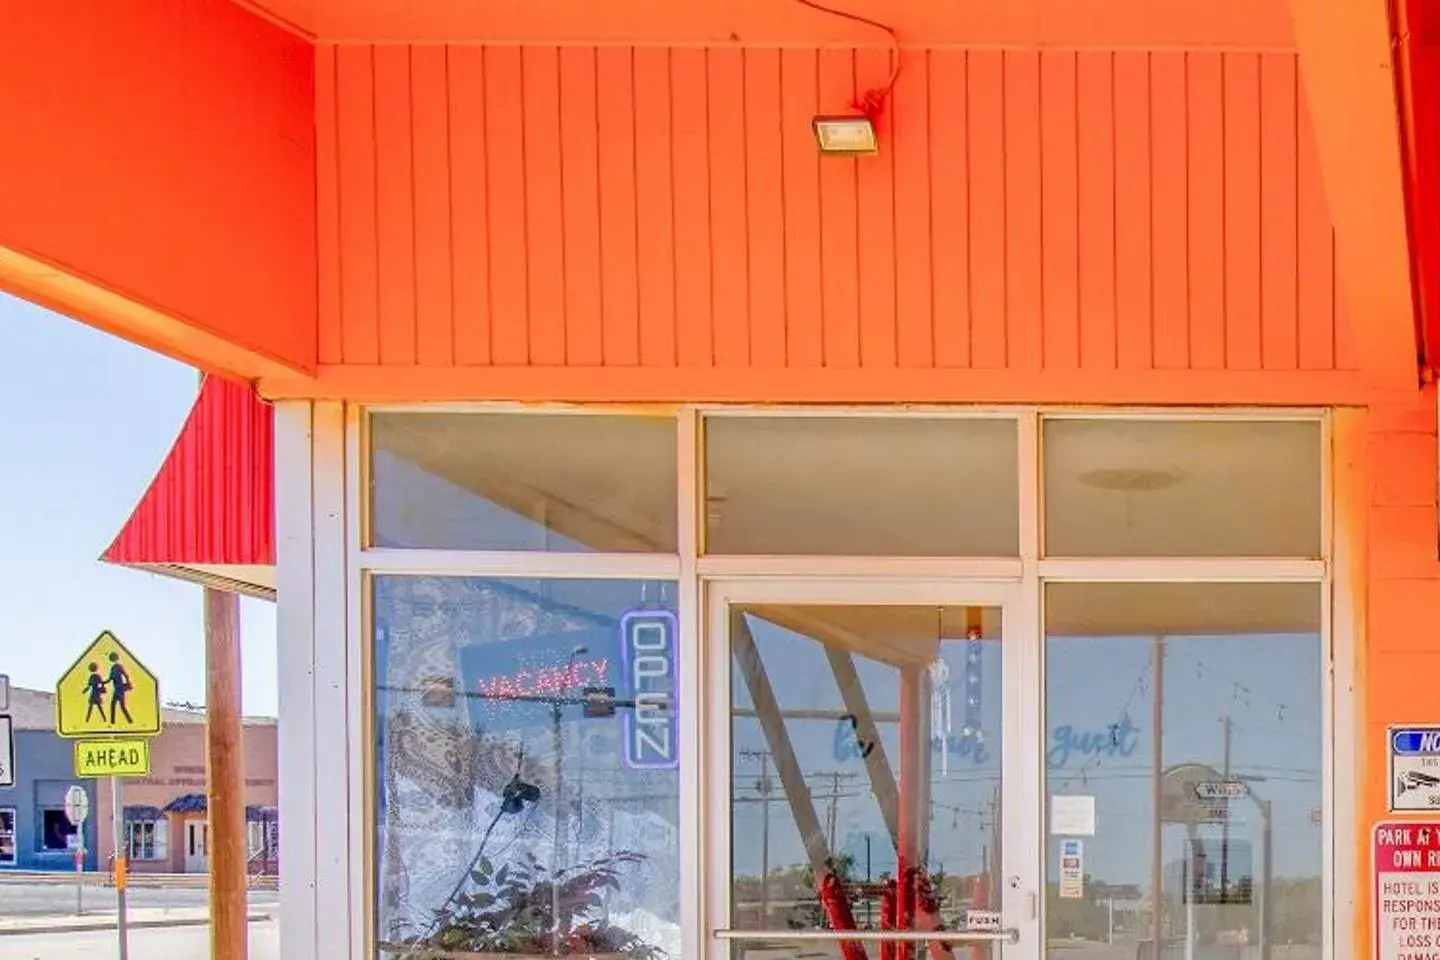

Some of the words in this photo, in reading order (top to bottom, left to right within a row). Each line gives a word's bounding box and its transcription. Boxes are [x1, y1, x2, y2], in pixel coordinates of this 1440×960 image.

[479, 658, 609, 699] VACANCY
[633, 622, 669, 760] OPEN
[86, 749, 139, 767] AHEAD
[1378, 829, 1412, 846] PARK
[1417, 829, 1430, 845] AT
[1393, 850, 1421, 867] OWN
[1384, 882, 1422, 895] HOTEL
[1428, 881, 1439, 894] IS
[1393, 917, 1416, 930] FOR
[1400, 935, 1431, 947] LOSS
